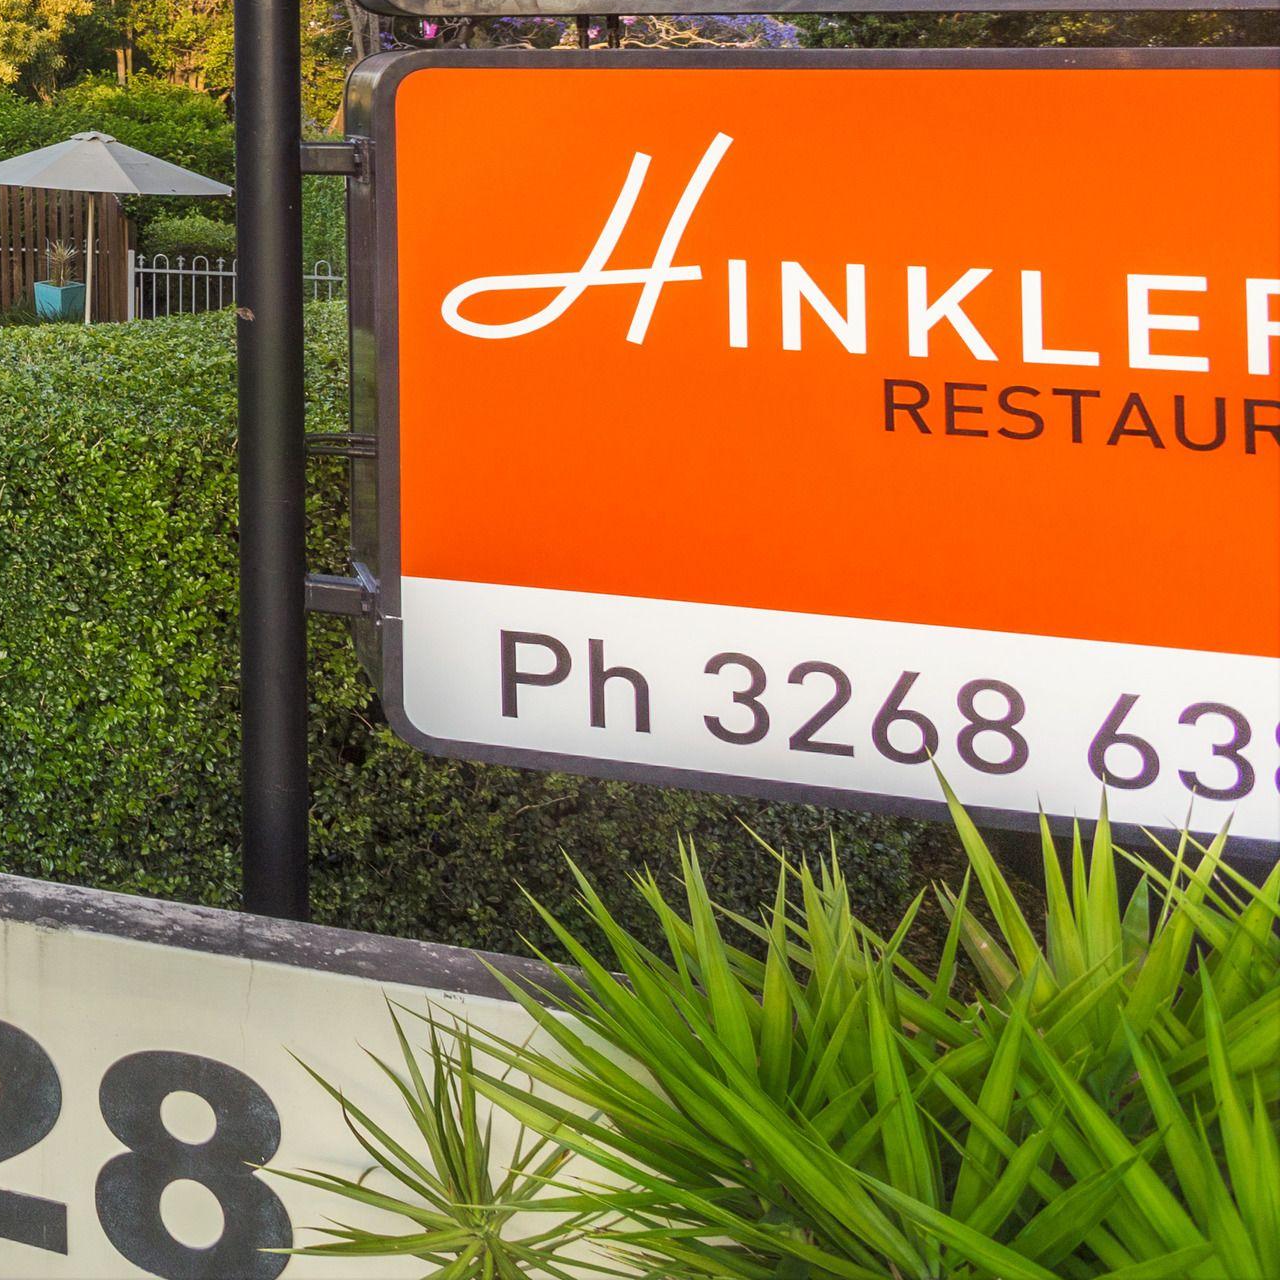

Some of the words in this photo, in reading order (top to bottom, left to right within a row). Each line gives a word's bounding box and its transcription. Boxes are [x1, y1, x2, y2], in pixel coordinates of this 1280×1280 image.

[883, 379, 1280, 455] RESTAUR
[500, 629, 651, 734] Ph
[703, 652, 1030, 775] 3268
[1087, 693, 1280, 801] 63
